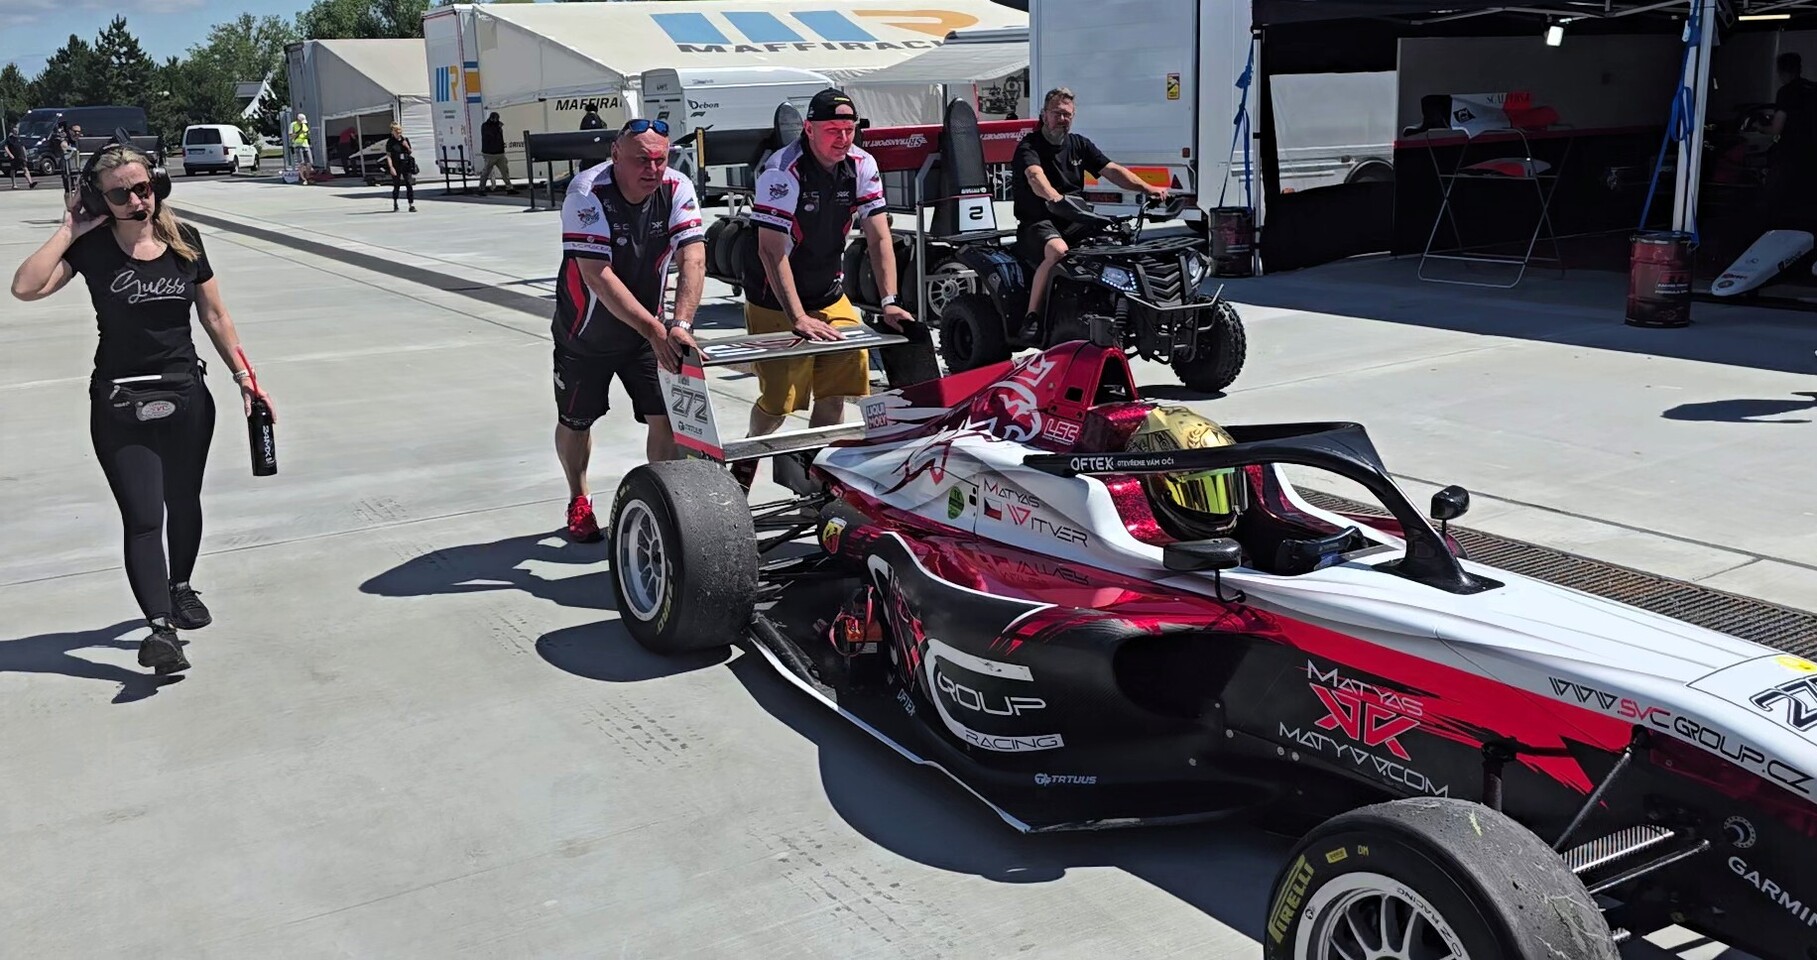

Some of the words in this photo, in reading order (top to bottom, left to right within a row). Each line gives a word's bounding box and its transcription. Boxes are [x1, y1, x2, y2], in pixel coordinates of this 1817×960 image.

[687, 100, 720, 110] Debon
[110, 269, 186, 304] Guess
[671, 384, 708, 424] 272
[868, 414, 888, 429] MOLY
[1146, 457, 1160, 466] VÁM
[1161, 456, 1175, 465] OČI
[984, 478, 1040, 508] MATYAS
[1006, 503, 1088, 548] WITVER
[937, 671, 1047, 716] GROUP
[1307, 659, 1423, 716] MATYAS
[965, 729, 1058, 750] RACING
[1052, 775, 1097, 785] TATUUS
[1267, 853, 1315, 944] PIRELLI
[1397, 887, 1440, 924] RACING
